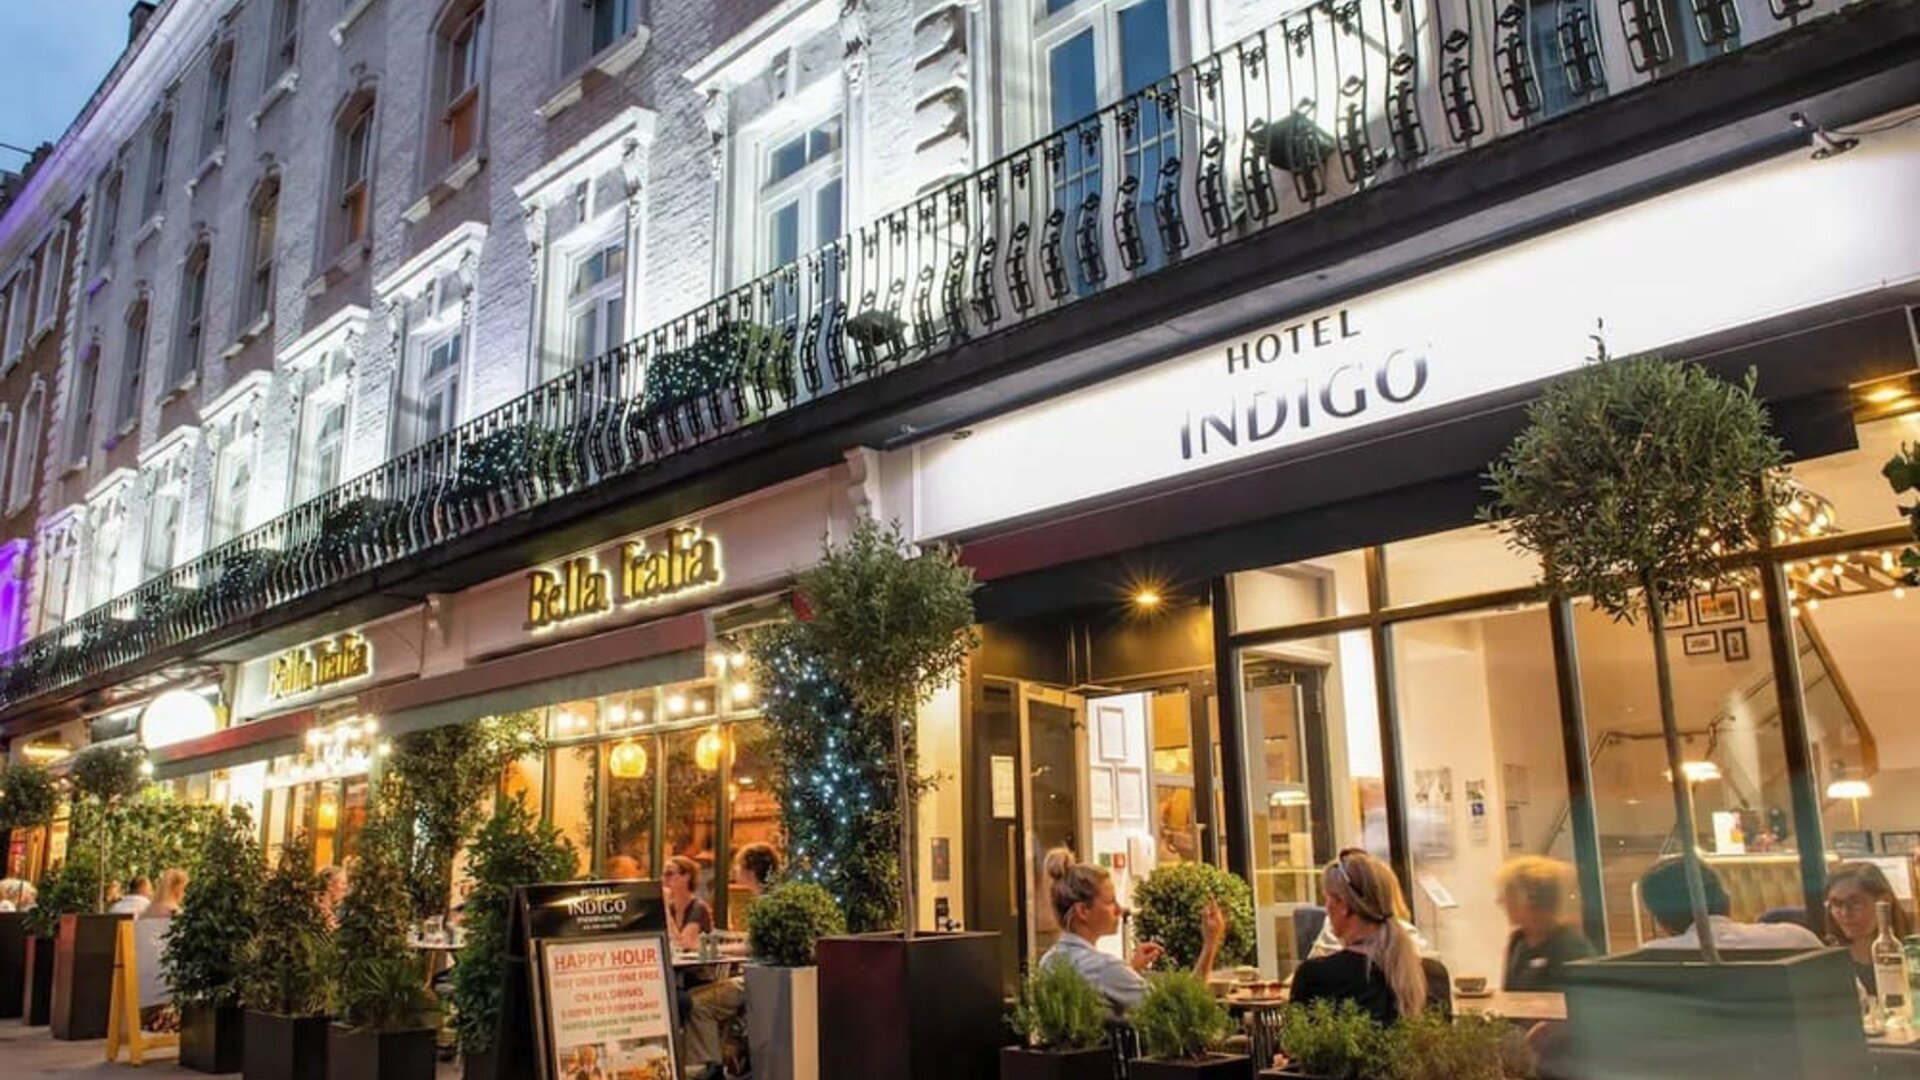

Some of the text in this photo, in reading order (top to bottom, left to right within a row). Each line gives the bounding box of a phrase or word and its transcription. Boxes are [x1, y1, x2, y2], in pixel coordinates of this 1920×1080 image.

[1226, 310, 1361, 374] HOTEL
[1180, 347, 1429, 460] INDIGO
[522, 527, 720, 631] Bella Italia
[567, 899, 627, 915] INDIGO
[554, 947, 656, 970] HAPPY HOUR
